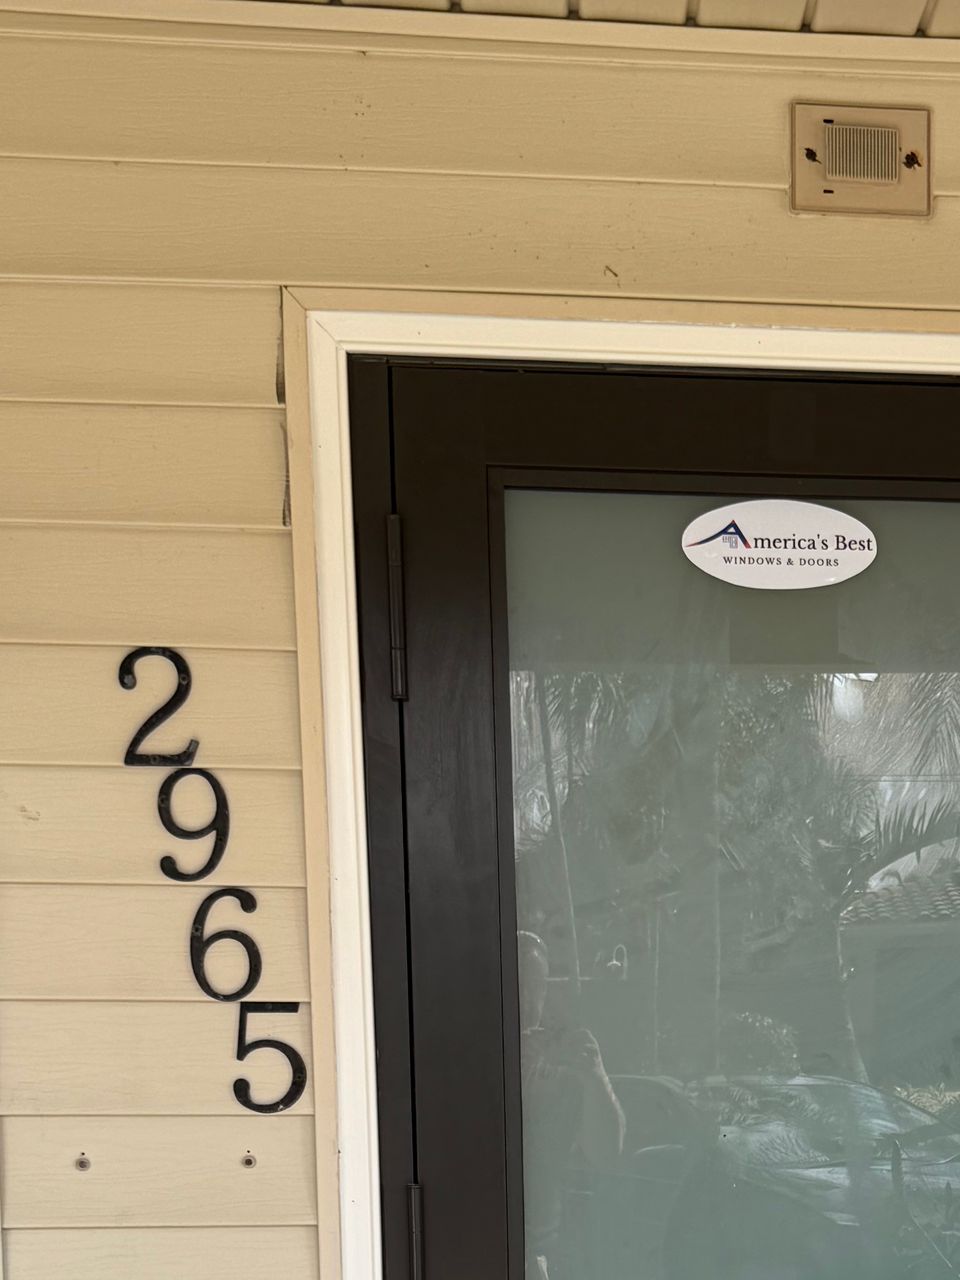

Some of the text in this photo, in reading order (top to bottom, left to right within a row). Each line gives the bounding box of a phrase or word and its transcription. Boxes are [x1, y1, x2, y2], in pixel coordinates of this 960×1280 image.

[685, 519, 874, 551] America's Best
[723, 556, 840, 567] WINDOWS & DOORS
[118, 645, 307, 1114] 2965
